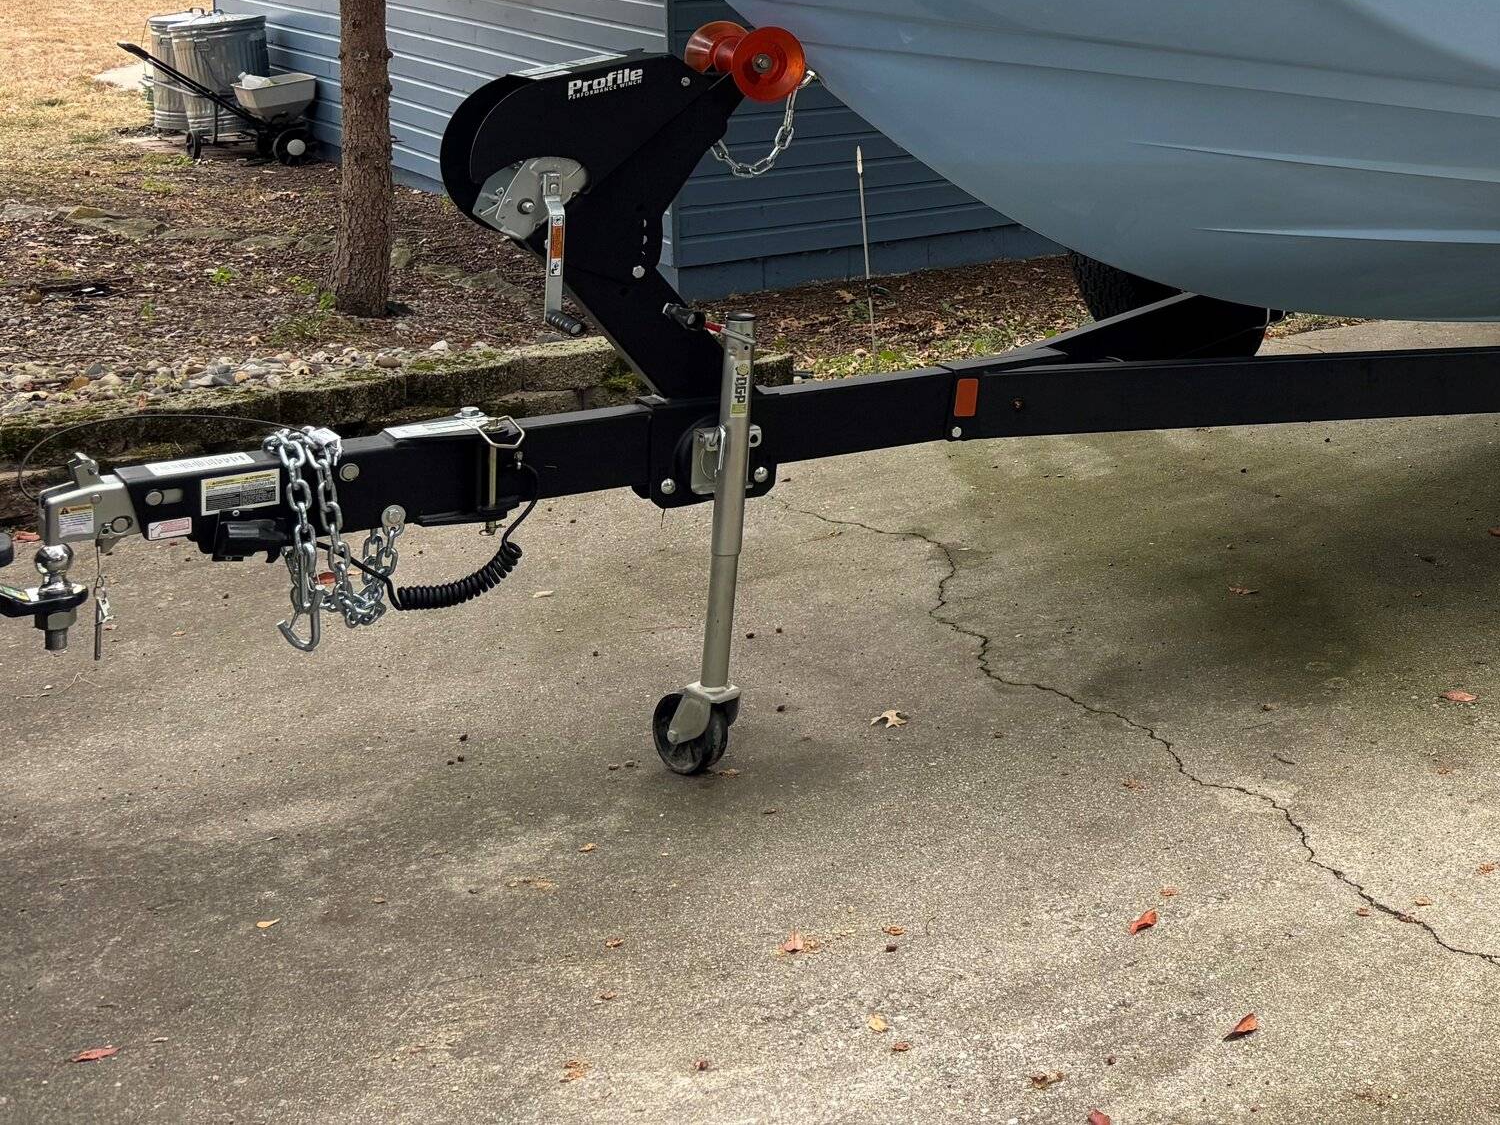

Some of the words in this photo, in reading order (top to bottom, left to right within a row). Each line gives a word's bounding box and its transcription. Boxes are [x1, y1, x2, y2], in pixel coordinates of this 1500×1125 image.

[568, 68, 643, 96] Profile
[568, 84, 617, 100] PERFORMANCE
[619, 79, 642, 89] WINCH
